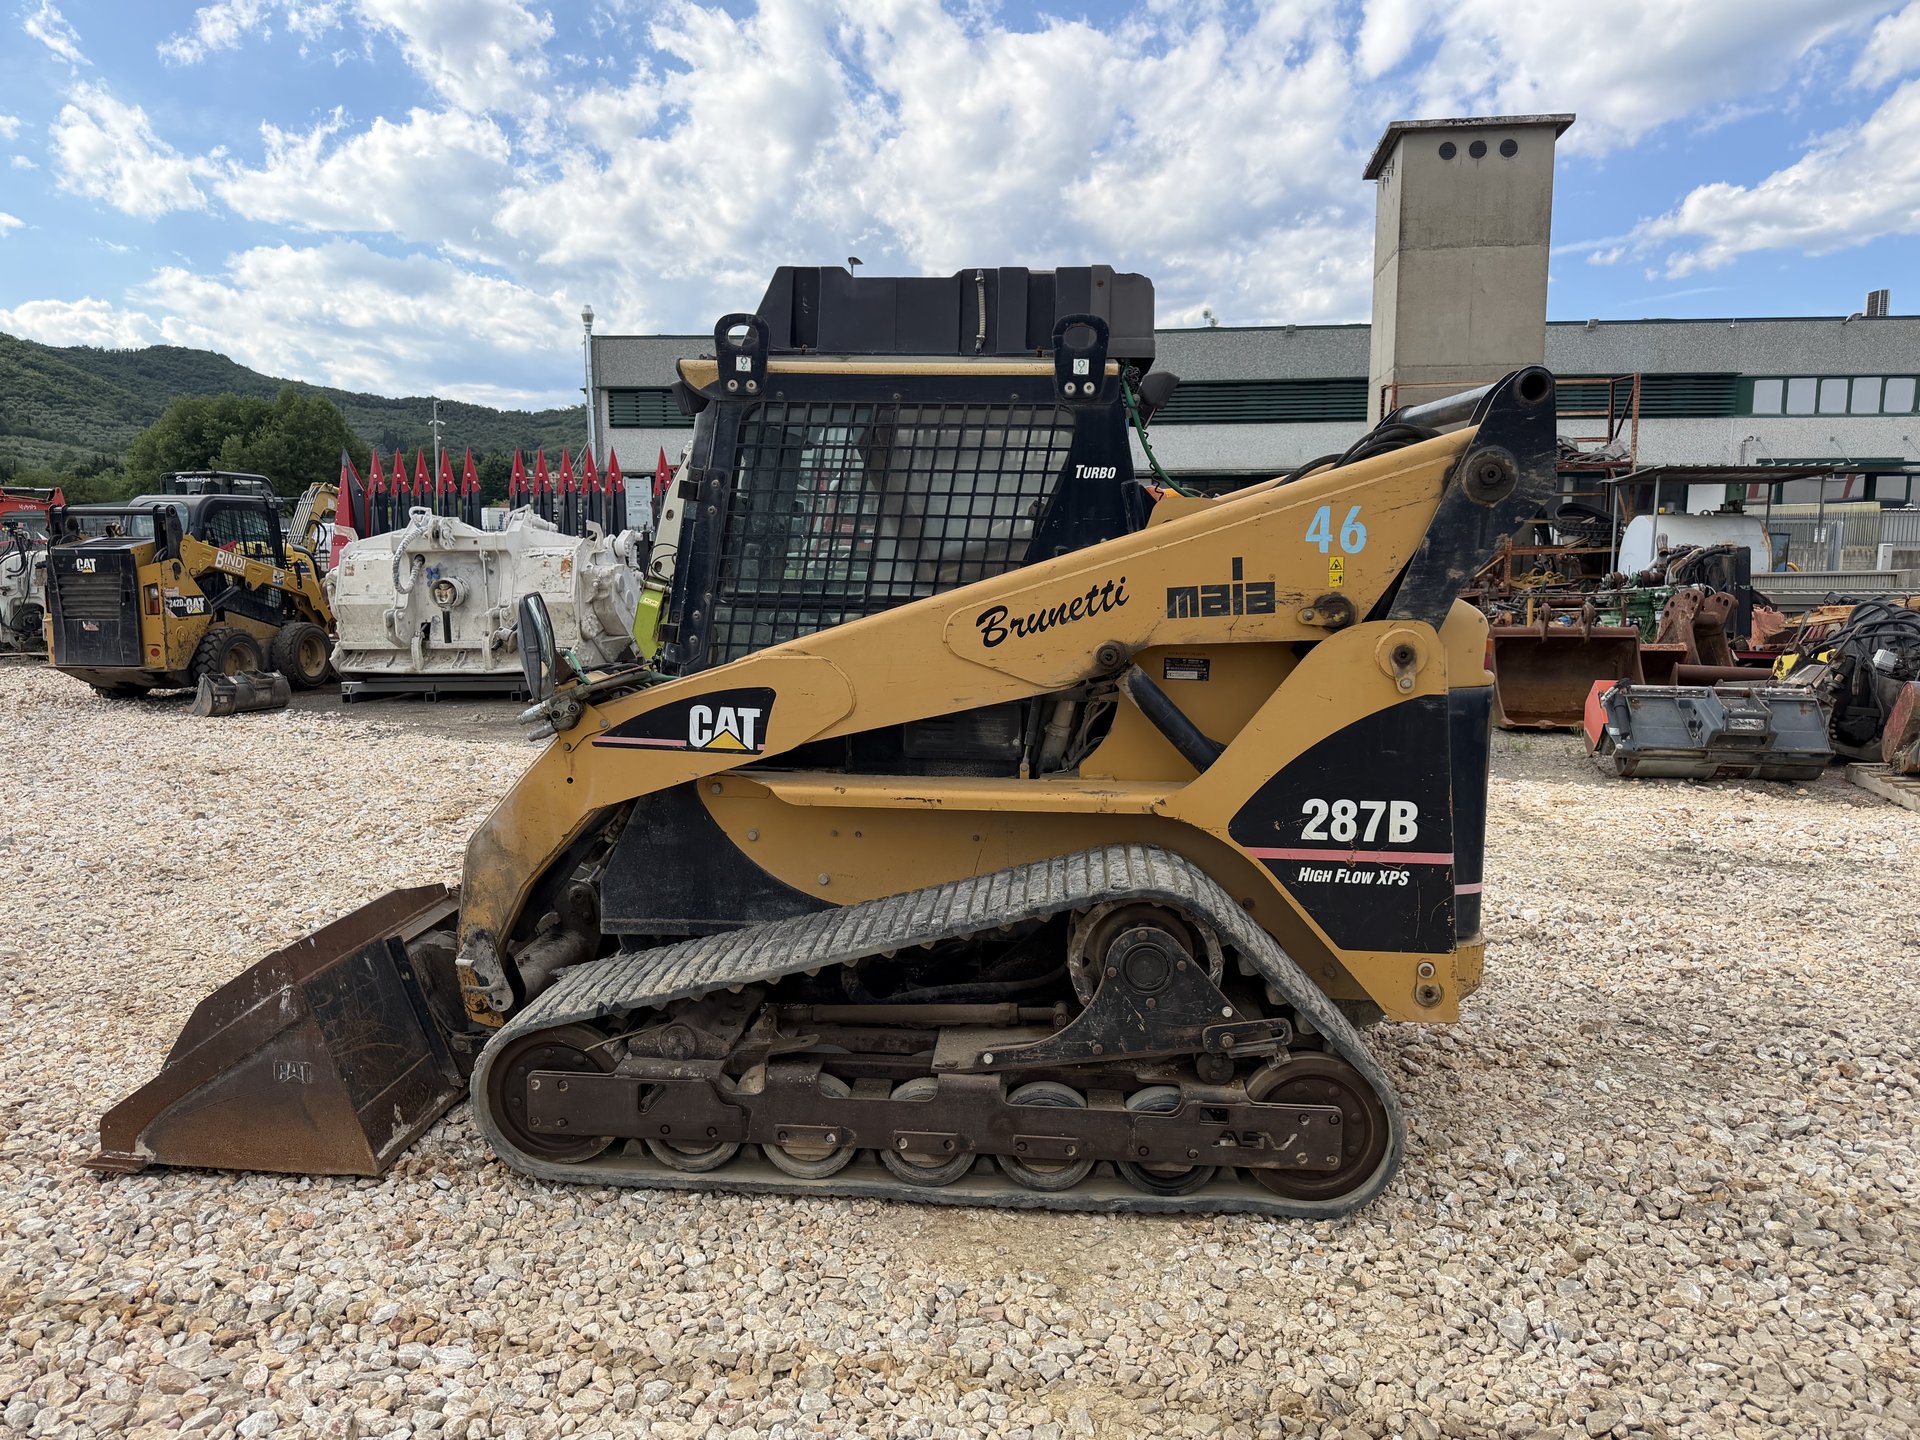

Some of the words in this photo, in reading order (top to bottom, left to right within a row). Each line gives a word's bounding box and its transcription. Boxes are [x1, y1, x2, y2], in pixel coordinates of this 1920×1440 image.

[1075, 464, 1117, 479] TURBO
[1305, 505, 1367, 554] 46
[76, 558, 96, 573] CAT
[214, 550, 247, 570] BINDI
[1167, 556, 1276, 619] maia
[976, 576, 1130, 648] Brunetti
[689, 704, 762, 751] CAT
[1300, 798, 1419, 843] 287B
[1298, 867, 1333, 883] HIGH
[1334, 868, 1376, 885] FLOW
[1376, 870, 1411, 886] XPS
[273, 1059, 312, 1084] CAT
